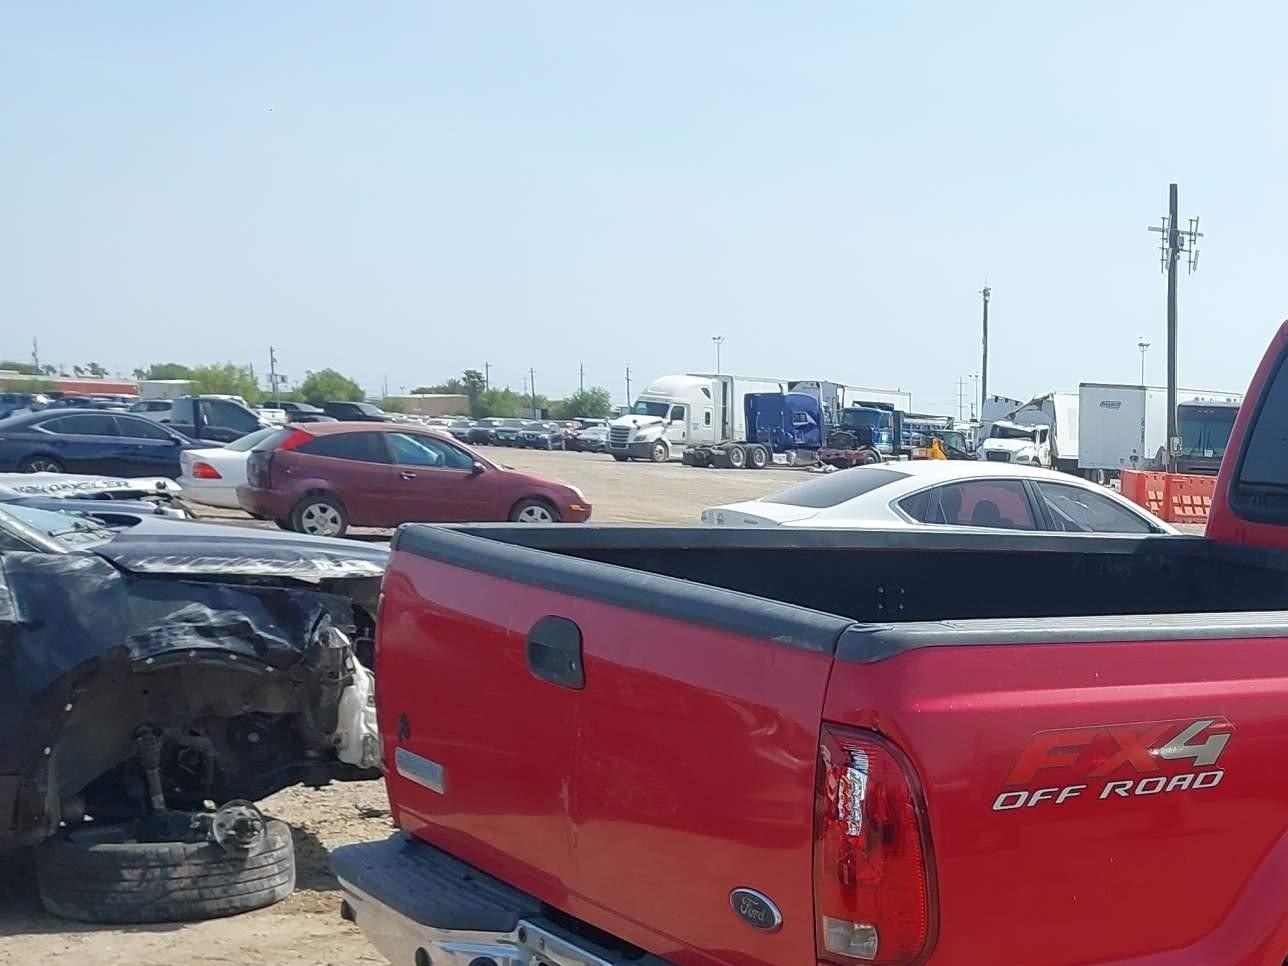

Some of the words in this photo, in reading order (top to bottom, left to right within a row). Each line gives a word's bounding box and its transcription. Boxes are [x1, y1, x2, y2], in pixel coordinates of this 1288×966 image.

[1004, 719, 1233, 785] FX4
[992, 785, 1087, 811] OFF
[1098, 770, 1225, 800] ROAD
[740, 896, 767, 921] Ford
